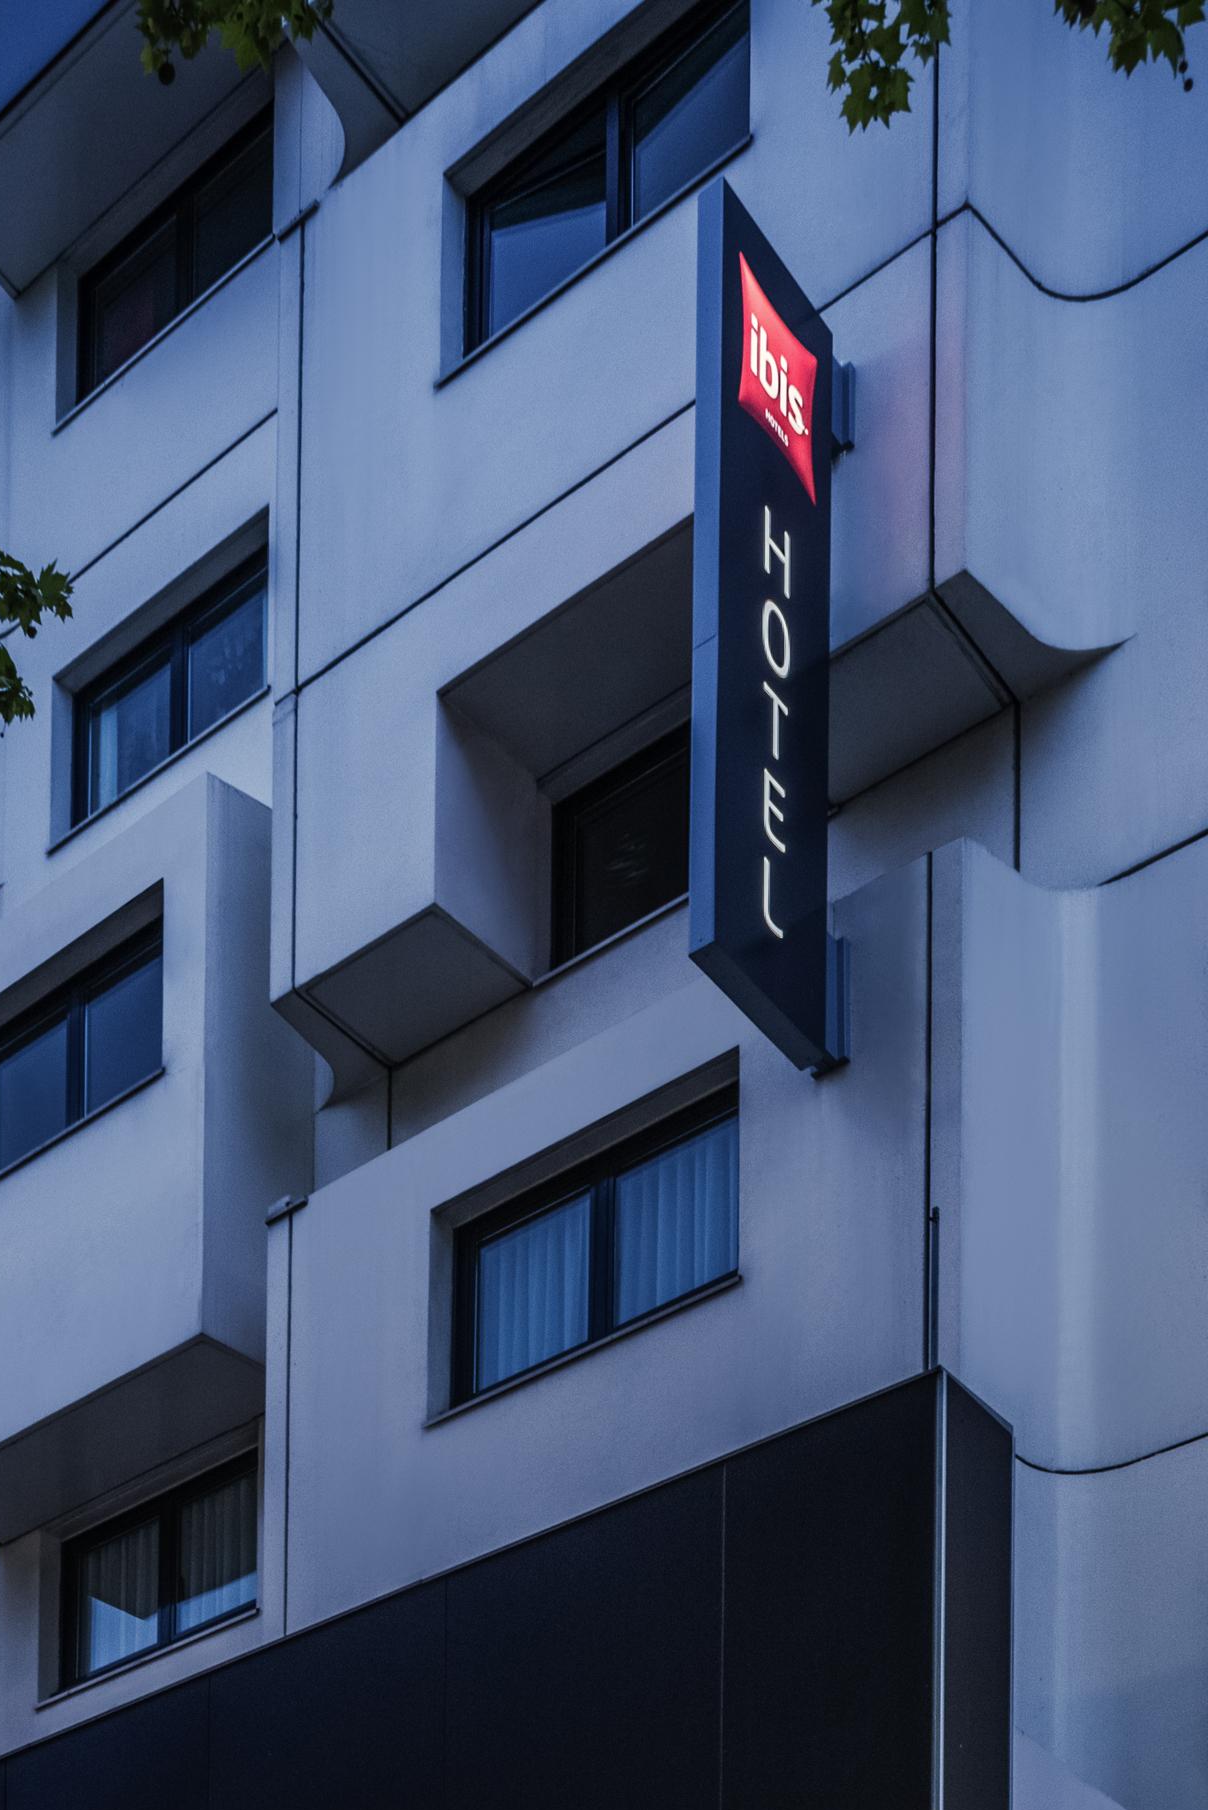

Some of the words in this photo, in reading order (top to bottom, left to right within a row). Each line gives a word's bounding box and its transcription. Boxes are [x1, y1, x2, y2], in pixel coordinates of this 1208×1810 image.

[750, 312, 807, 435] ibis
[765, 407, 790, 447] HOTELS
[762, 505, 791, 939] HOTEL
